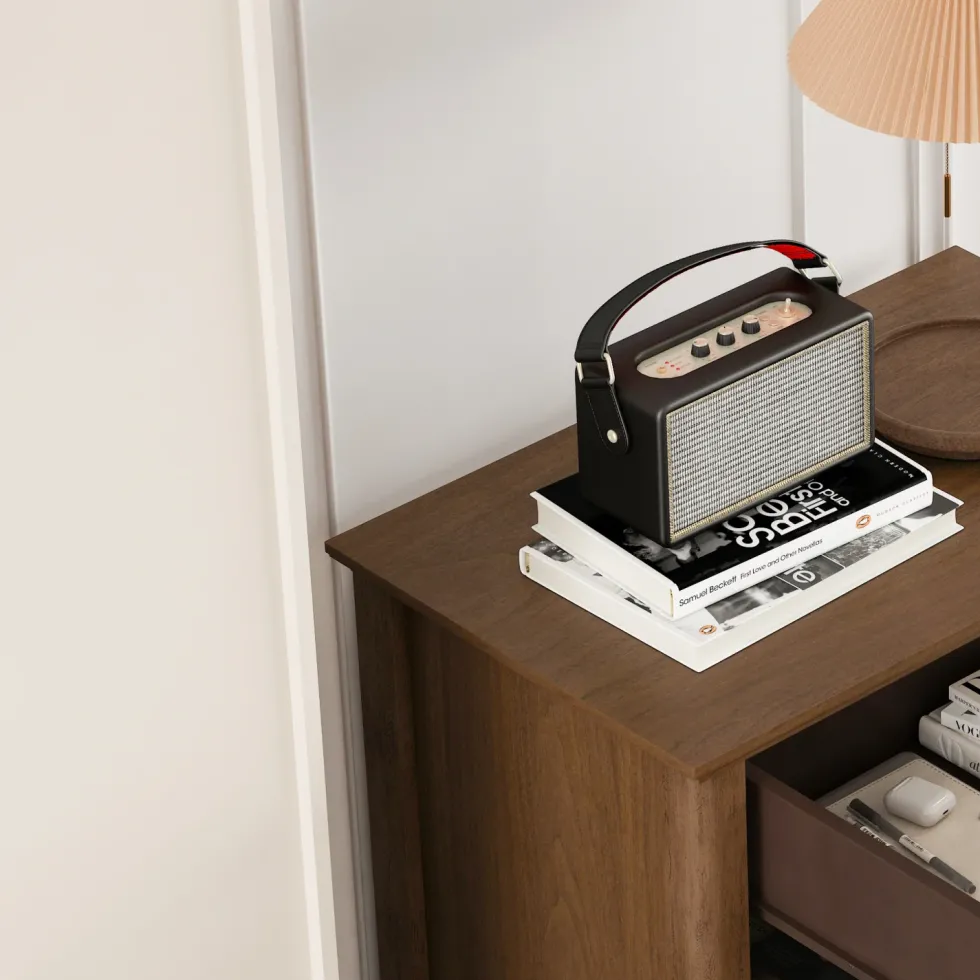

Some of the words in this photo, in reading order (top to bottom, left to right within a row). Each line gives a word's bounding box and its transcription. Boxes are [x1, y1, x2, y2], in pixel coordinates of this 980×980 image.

[678, 588, 708, 607] Samuel
[708, 575, 737, 593] Beckett
[740, 570, 752, 580] First
[752, 564, 767, 575] Love
[767, 557, 780, 567] and
[780, 550, 797, 561] Other
[798, 538, 823, 554] Novellas
[969, 761, 980, 773] at
